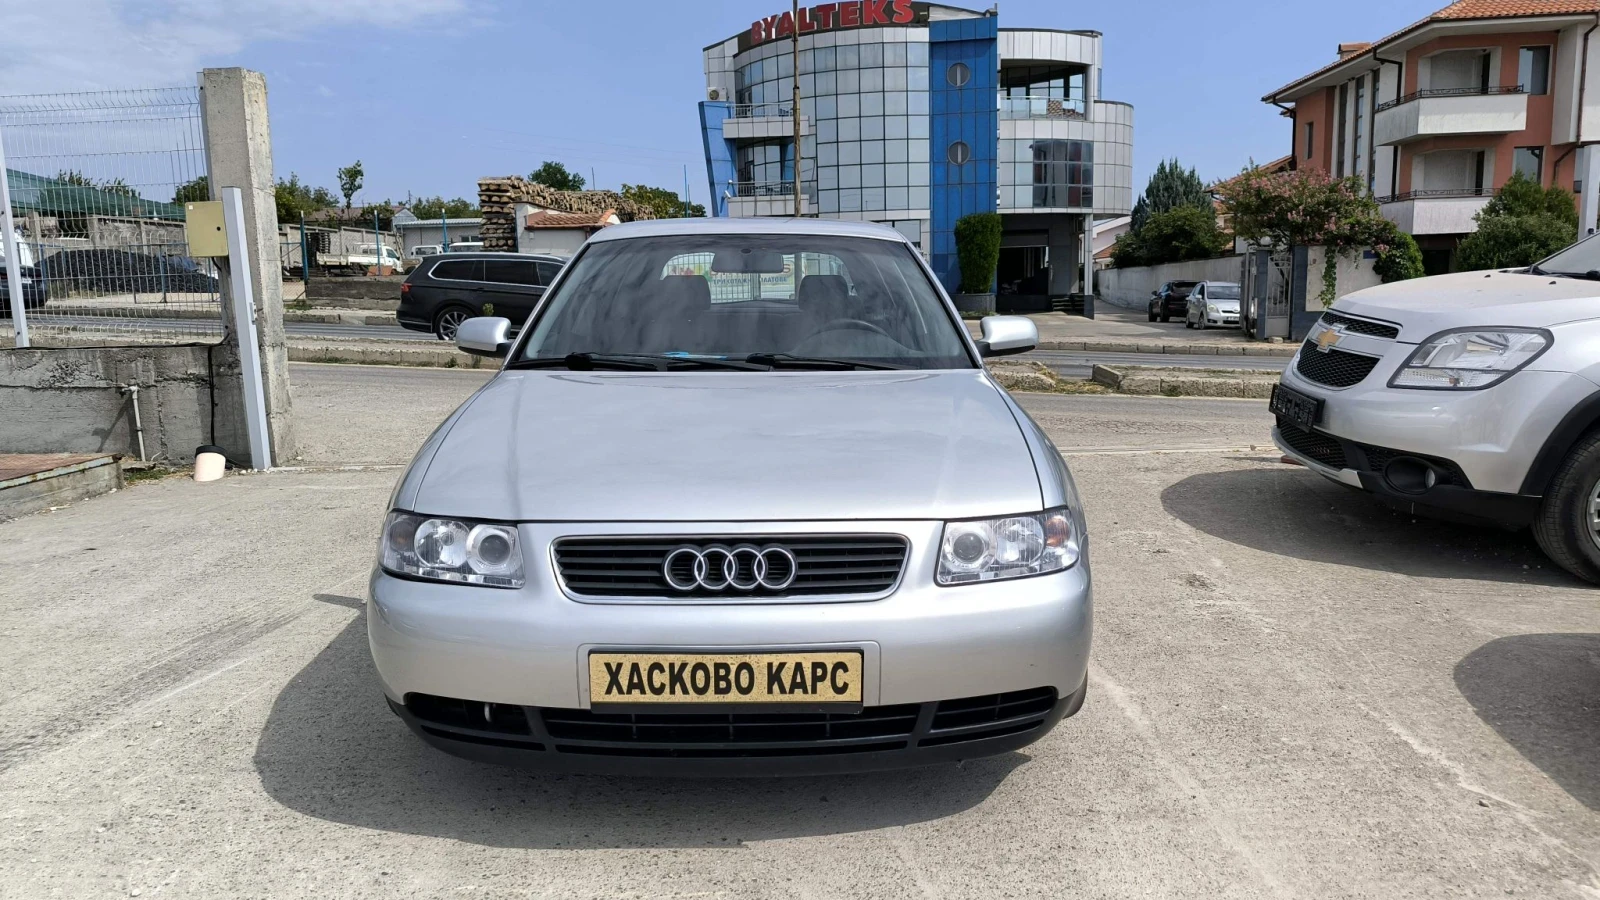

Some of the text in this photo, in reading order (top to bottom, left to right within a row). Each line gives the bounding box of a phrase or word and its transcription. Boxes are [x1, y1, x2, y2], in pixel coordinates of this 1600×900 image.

[751, 0, 914, 46] BYALTEKS
[604, 661, 850, 695] ХАСКОВО КАРС
